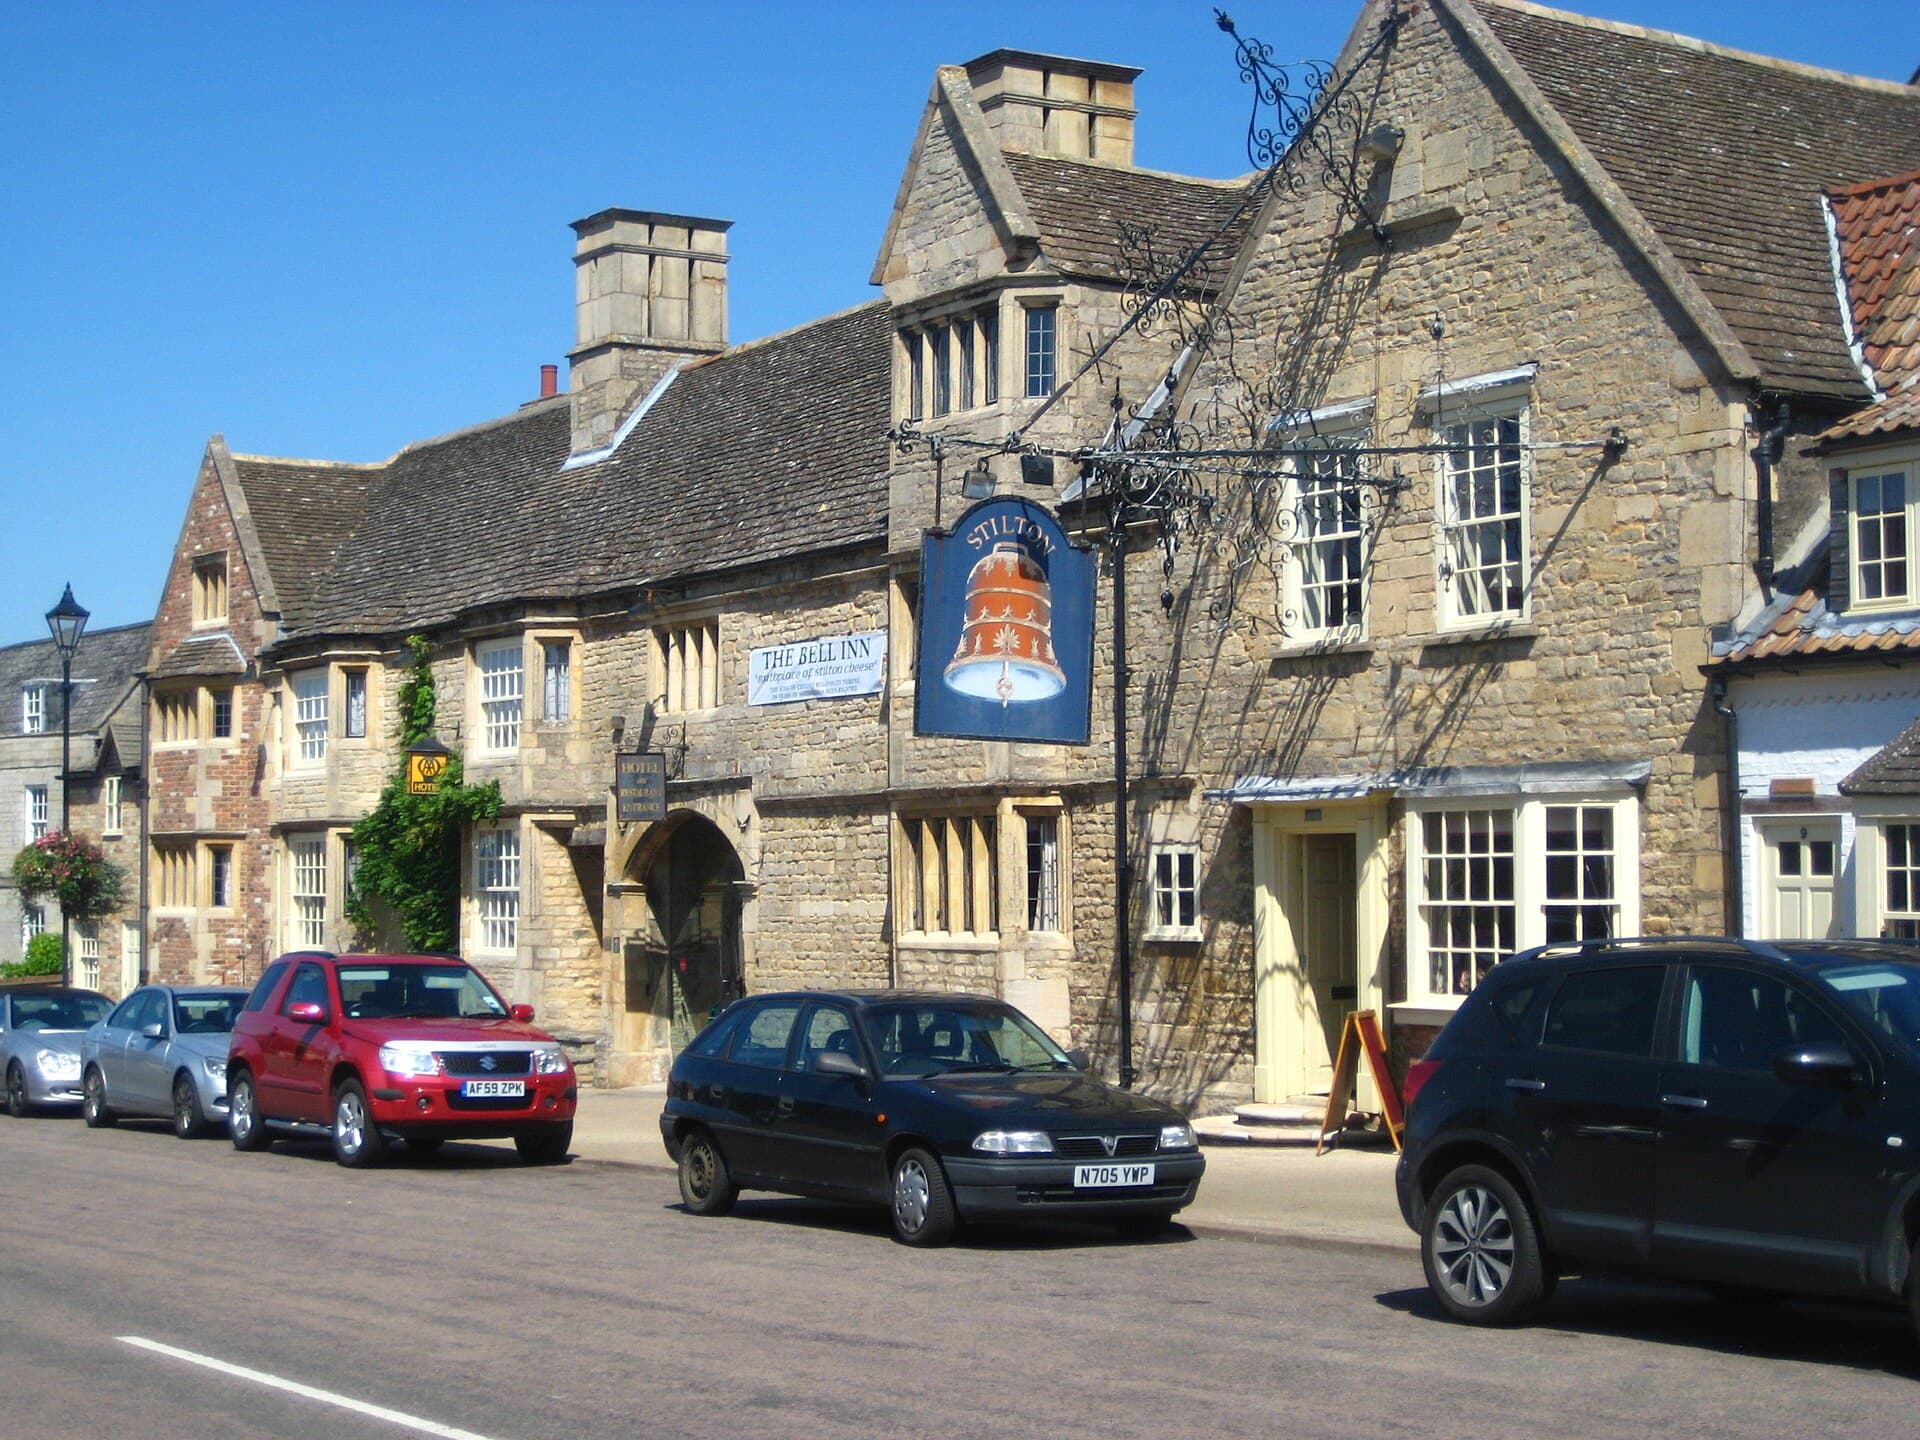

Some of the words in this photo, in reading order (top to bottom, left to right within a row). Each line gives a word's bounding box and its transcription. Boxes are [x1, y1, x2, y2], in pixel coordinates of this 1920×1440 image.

[966, 515, 1057, 556] STILTON
[762, 648, 793, 670] THE
[797, 642, 836, 666] BELL
[841, 637, 871, 659] INN
[622, 762, 659, 774] HOTEL
[414, 783, 440, 791] HOTE
[469, 1082, 498, 1094] AF59
[501, 1082, 522, 1094] ZPK
[1080, 1168, 1118, 1184] N705
[1123, 1167, 1149, 1182] YWP
